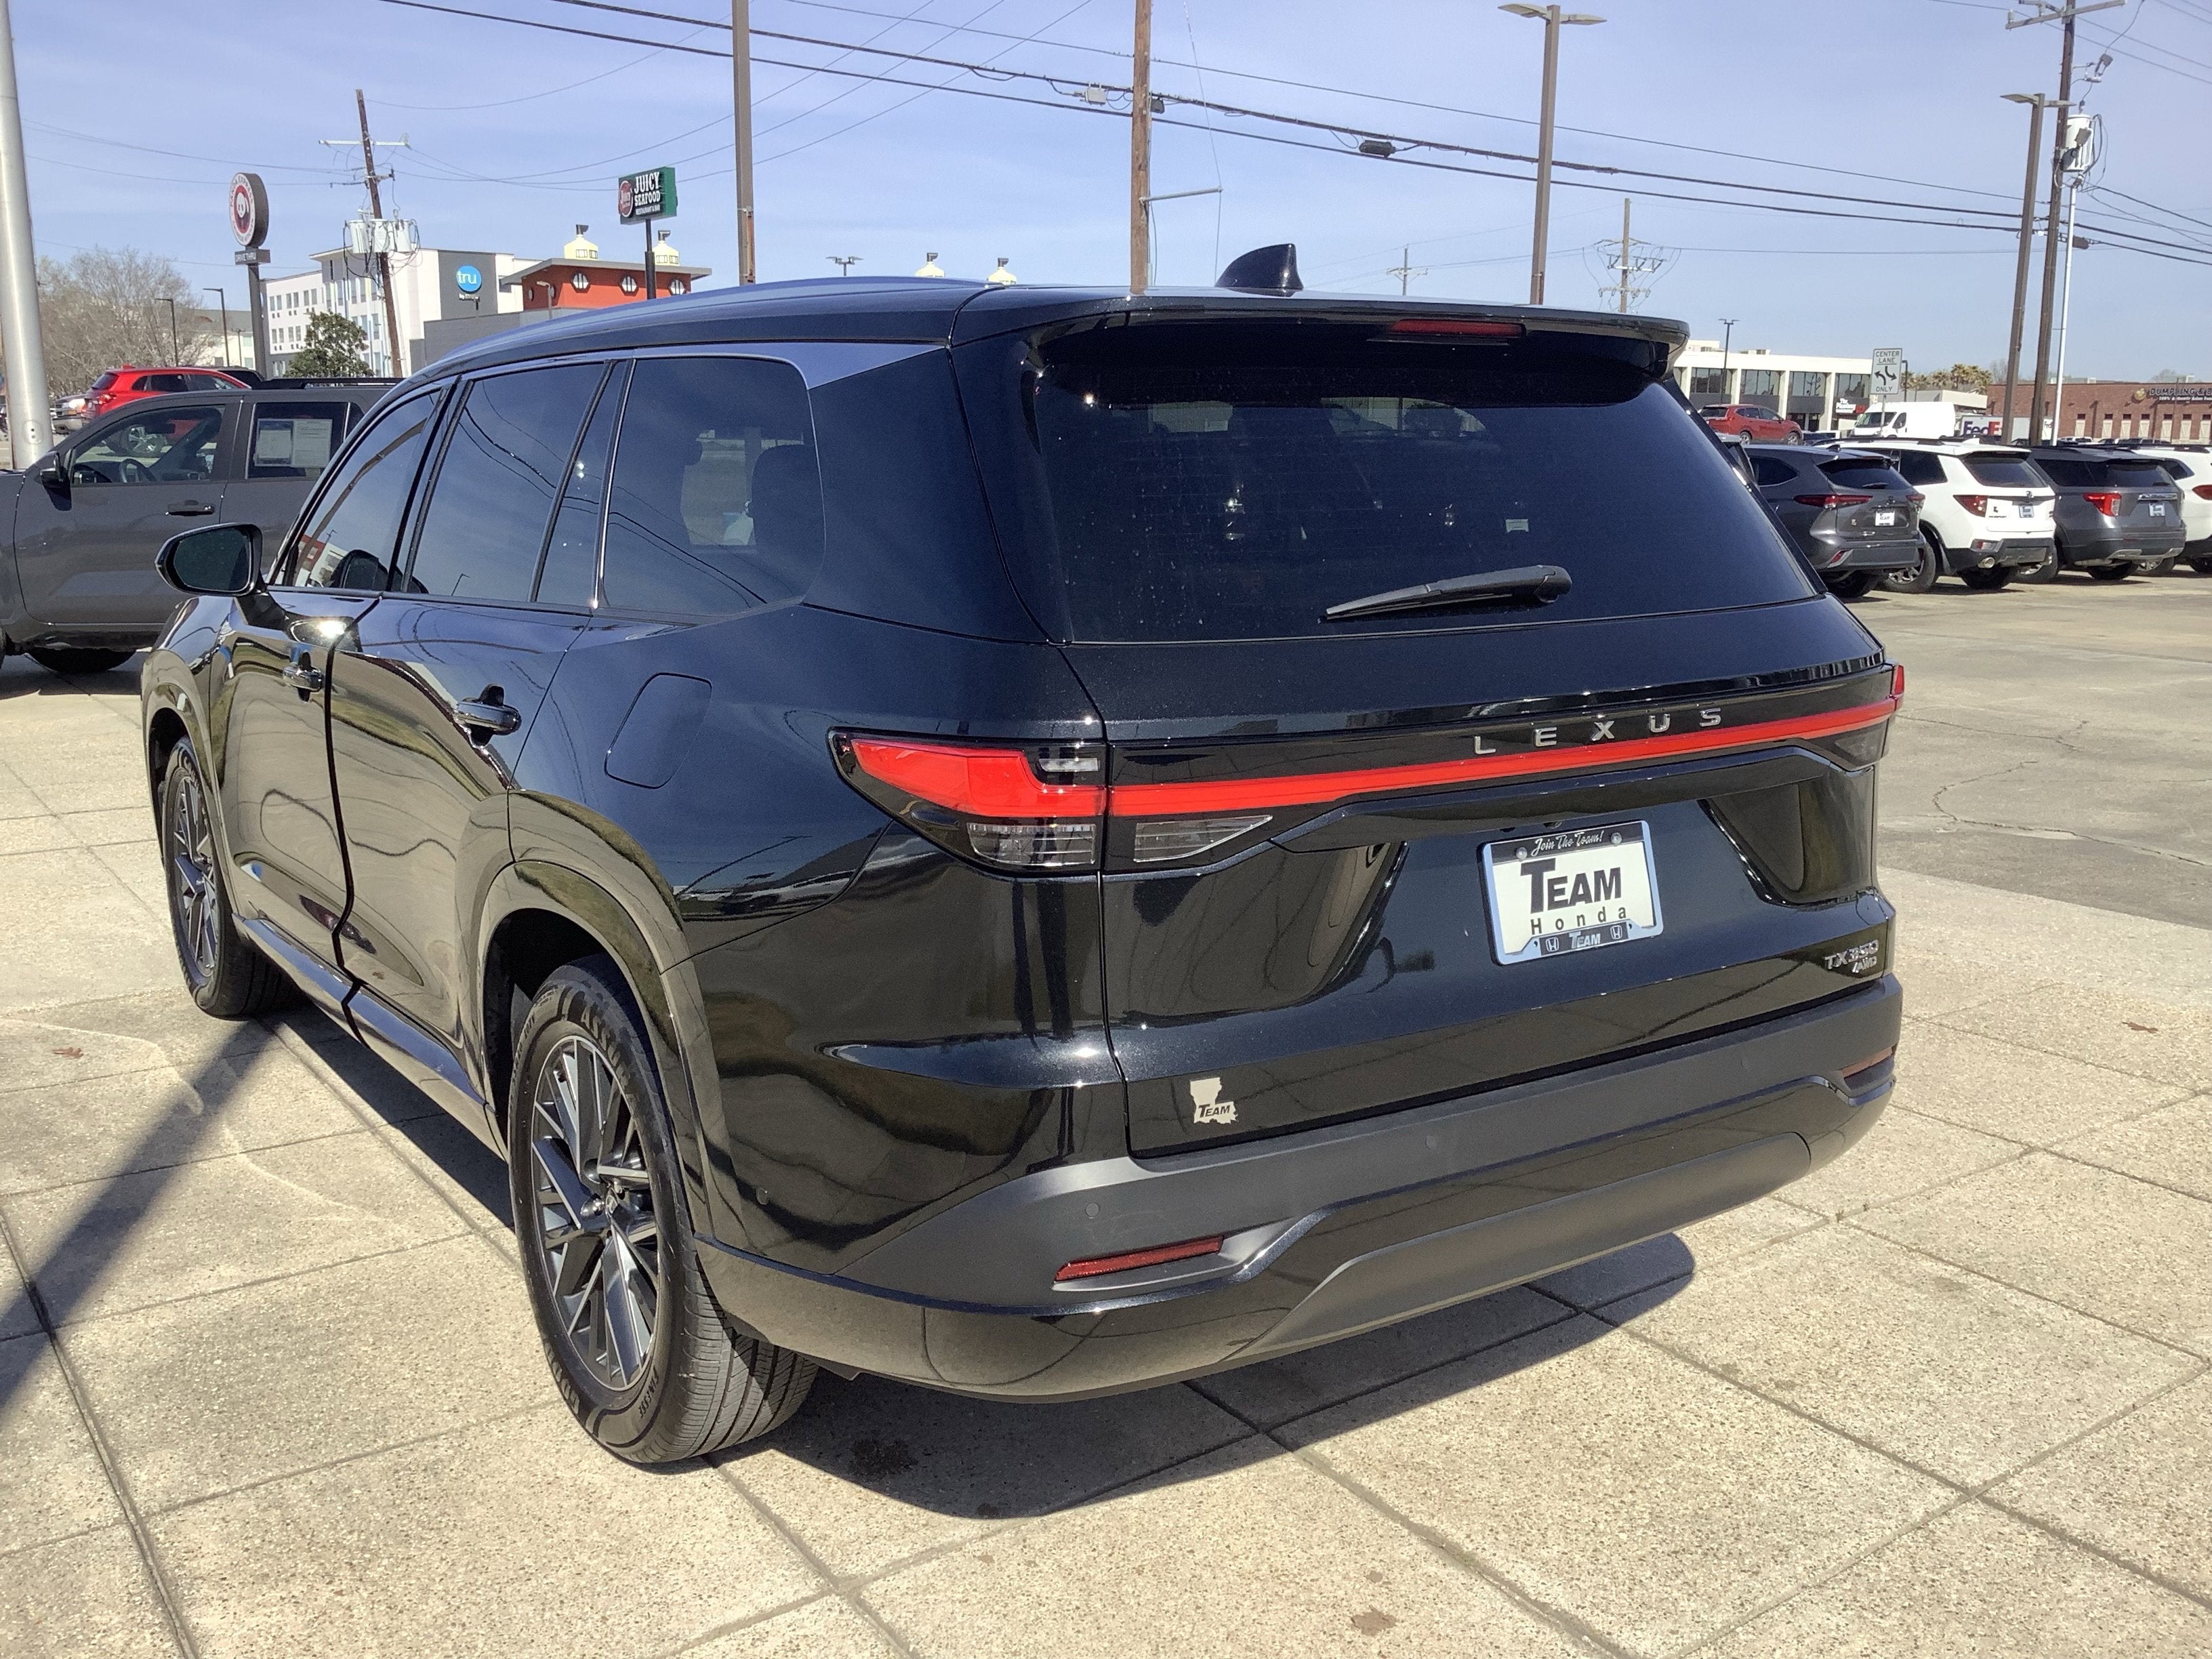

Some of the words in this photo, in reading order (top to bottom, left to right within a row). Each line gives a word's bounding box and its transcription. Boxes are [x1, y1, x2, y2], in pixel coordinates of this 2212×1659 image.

[634, 171, 659, 194] JUICY
[634, 190, 660, 207] SEAFOOD
[456, 271, 476, 284] tru
[1473, 707, 1722, 755] LEXUS
[1530, 838, 1555, 857] Join
[1555, 834, 1574, 849] The
[1574, 830, 1604, 846] Team!
[1520, 858, 1622, 914] TEAM
[1530, 907, 1626, 935] Honda
[1569, 931, 1601, 949] TEAM
[1198, 1104, 1231, 1118] TEAM
